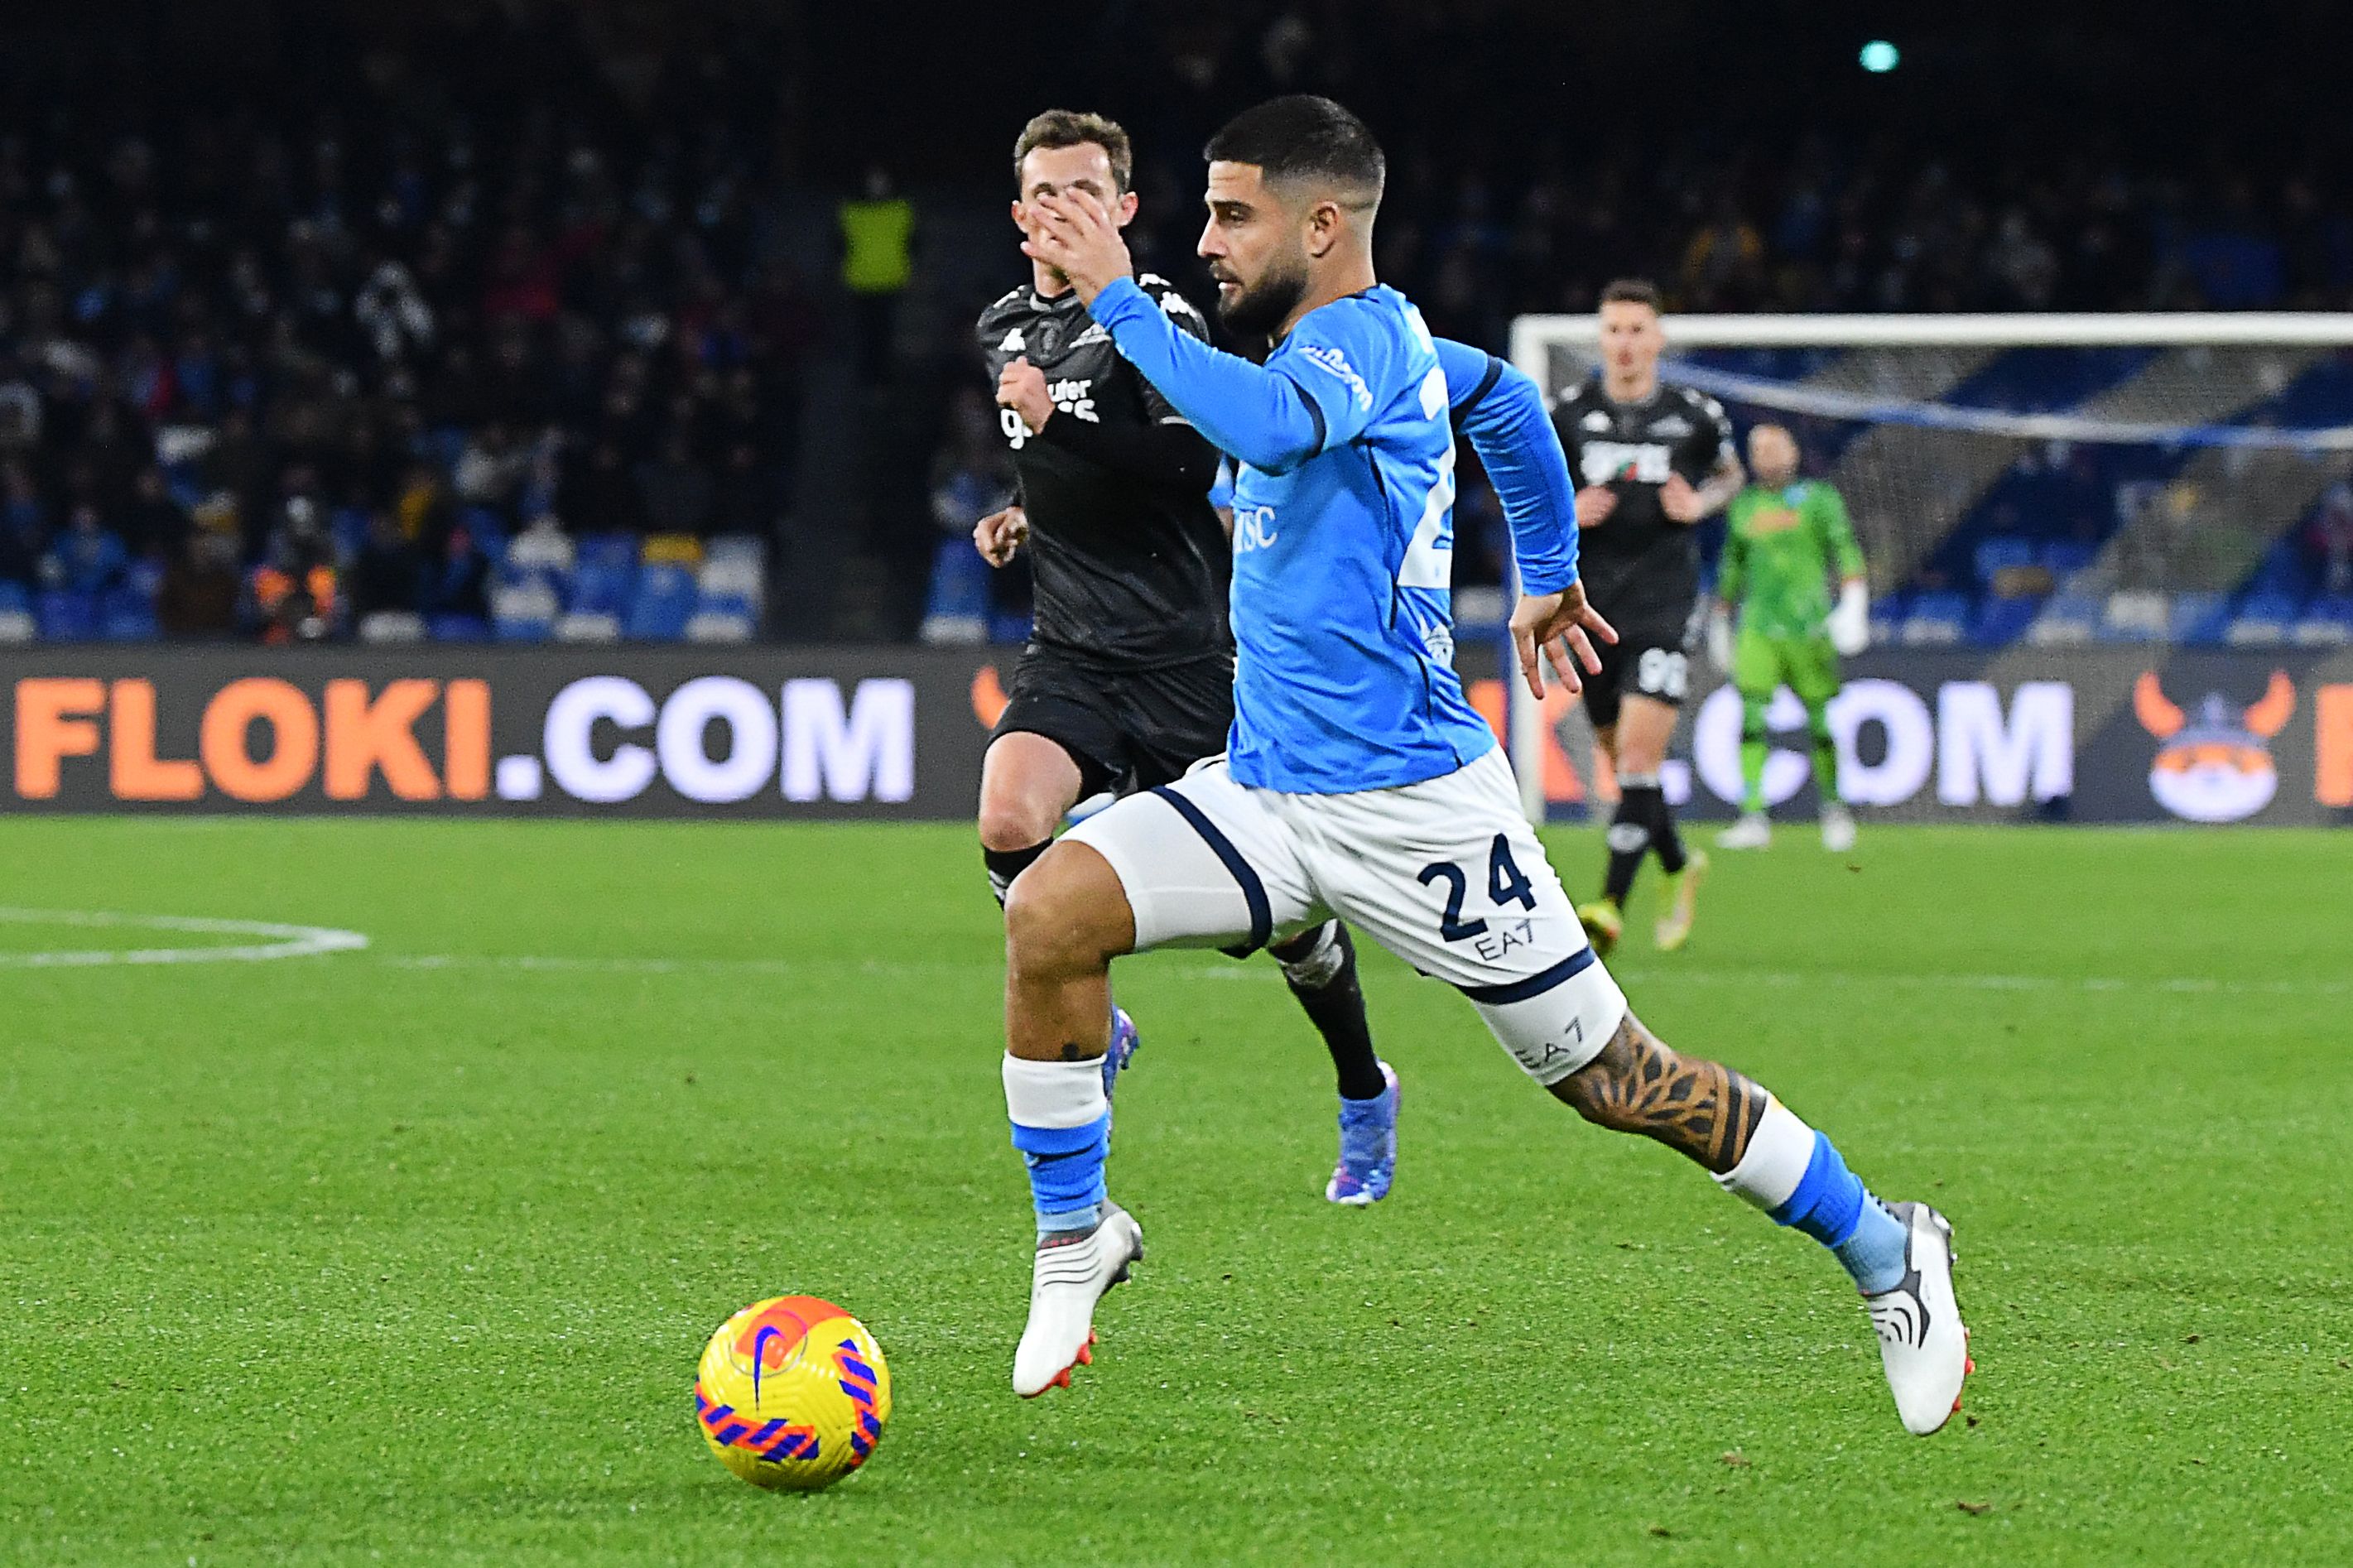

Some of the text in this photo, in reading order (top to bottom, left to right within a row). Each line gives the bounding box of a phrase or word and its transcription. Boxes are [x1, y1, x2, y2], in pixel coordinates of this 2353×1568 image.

[14, 676, 913, 803] FLOKI.COM
[1417, 833, 1537, 942] 24
[1475, 918, 1533, 961] EA7
[1514, 1015, 1583, 1070] EA7
